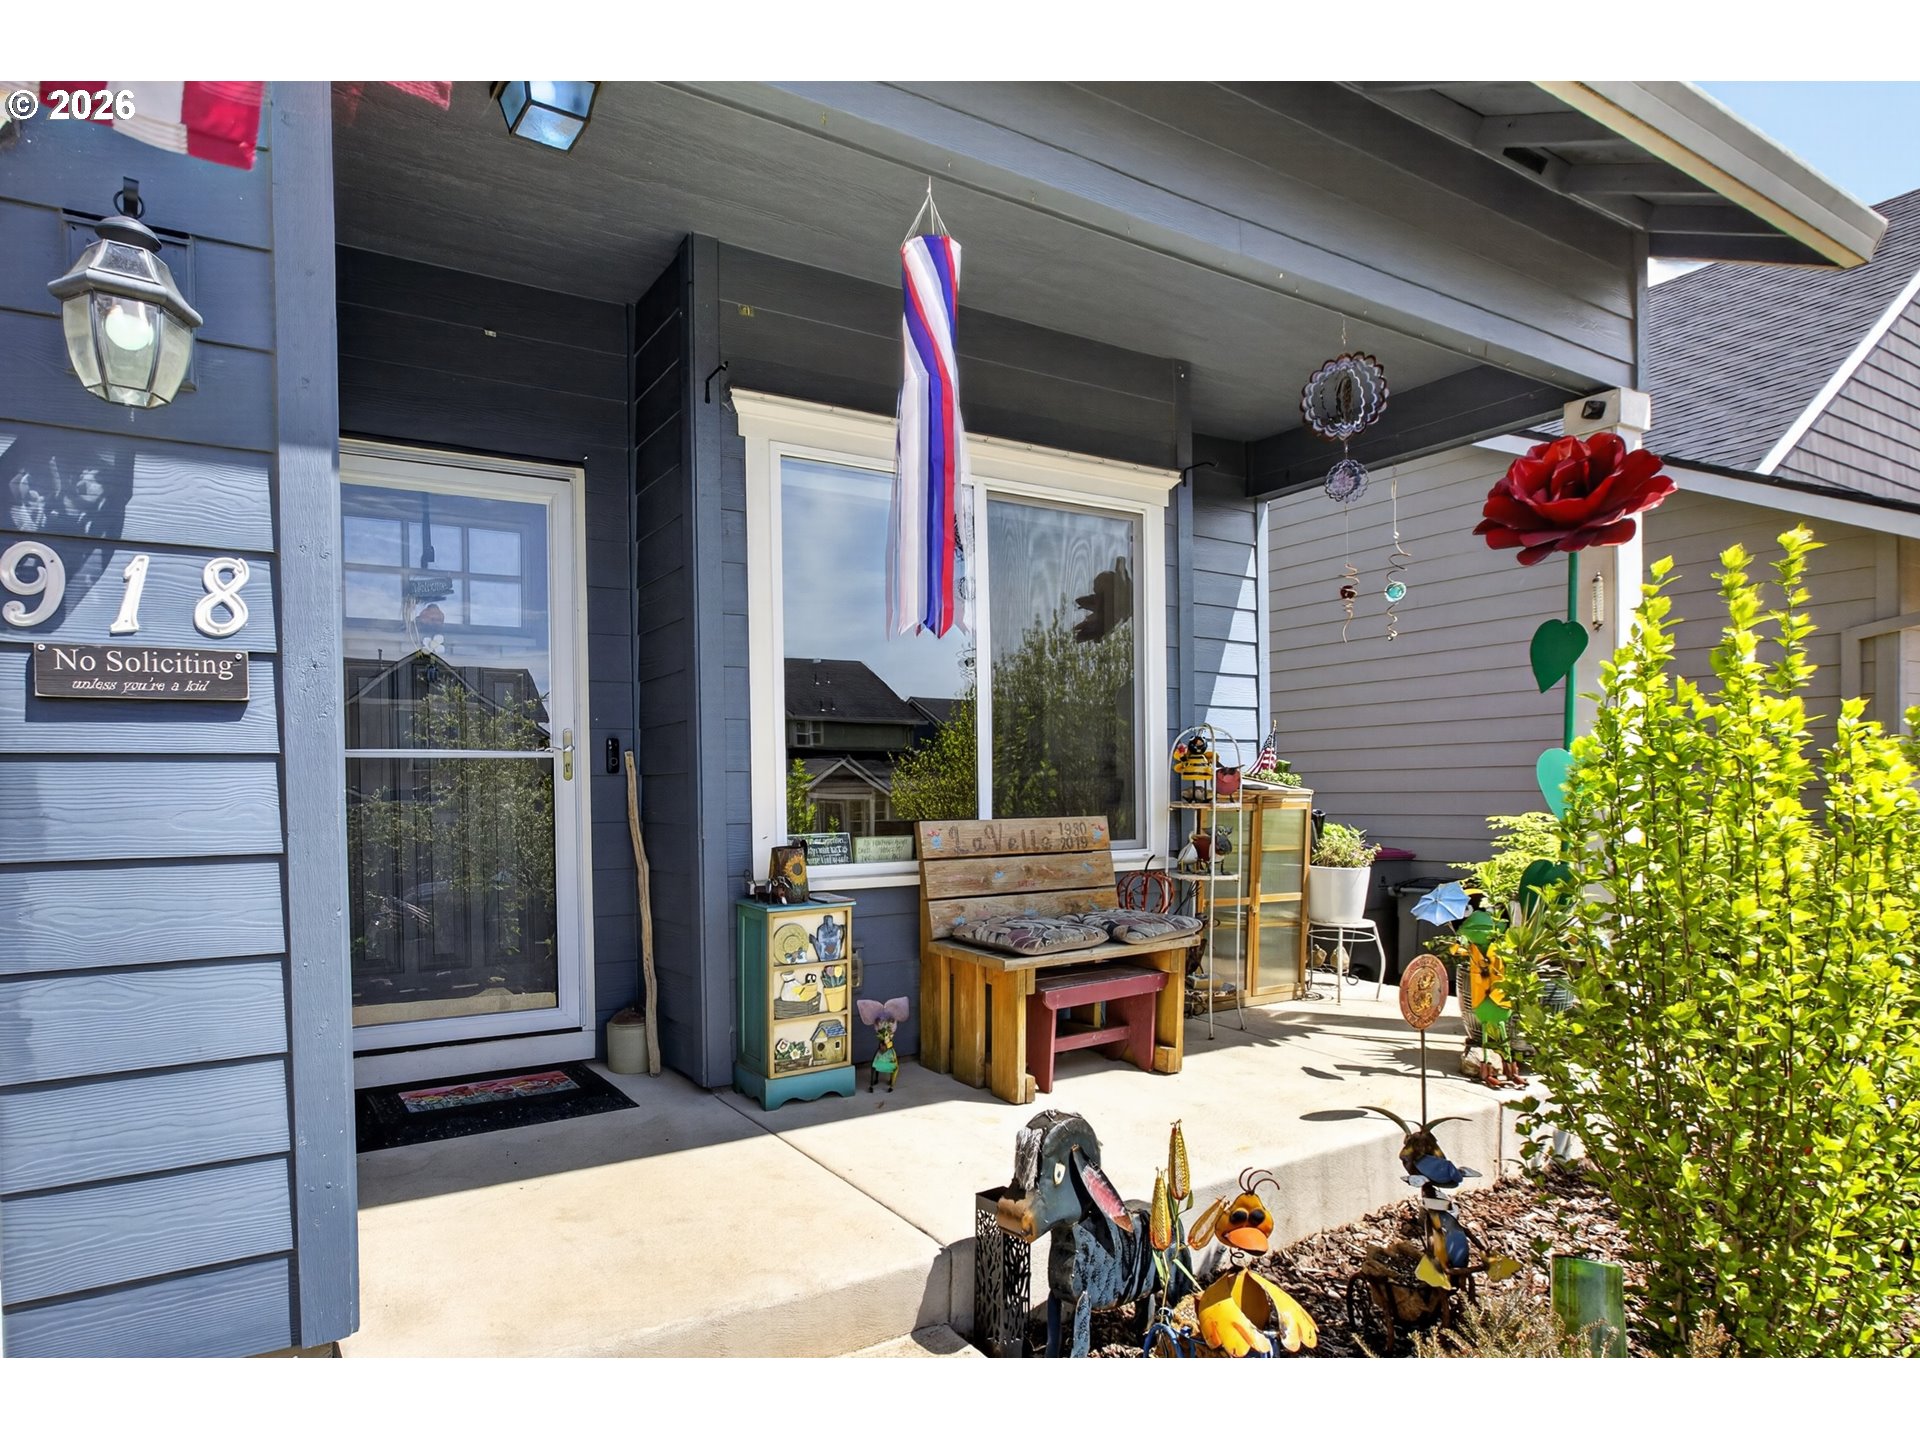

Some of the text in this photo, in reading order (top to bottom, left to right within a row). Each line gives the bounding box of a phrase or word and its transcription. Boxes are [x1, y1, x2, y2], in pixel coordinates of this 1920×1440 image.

[0, 541, 250, 637] 918
[52, 648, 234, 681] No Soliciting
[72, 677, 210, 694] unless you're a kid
[1060, 836, 1089, 851] 2019
